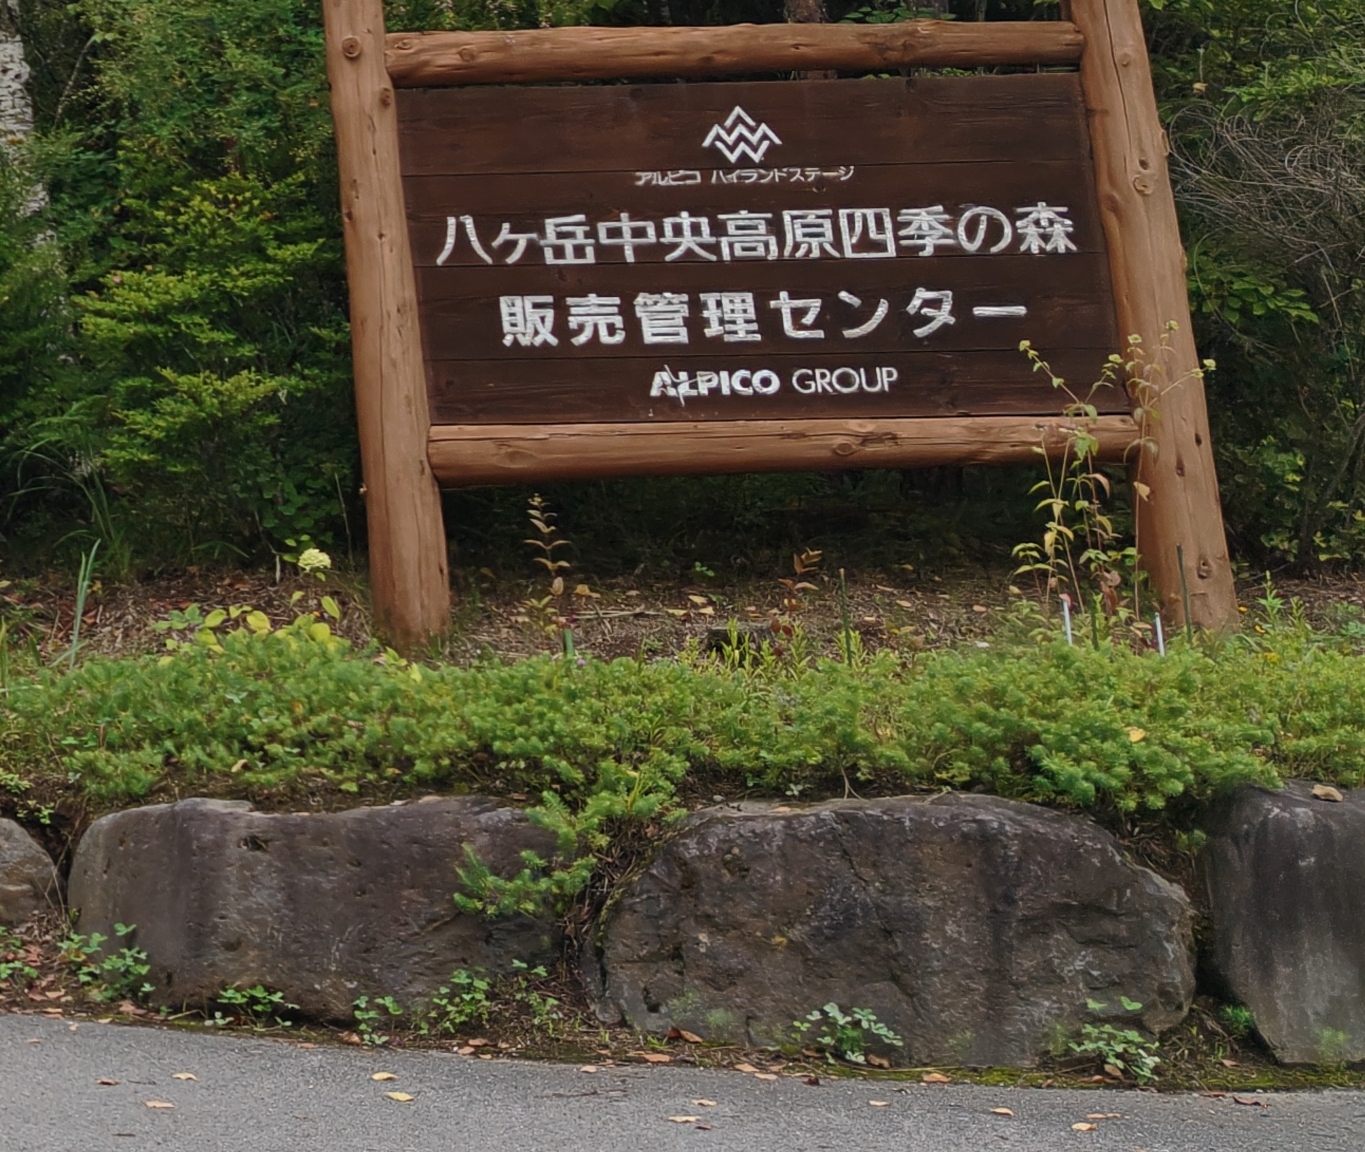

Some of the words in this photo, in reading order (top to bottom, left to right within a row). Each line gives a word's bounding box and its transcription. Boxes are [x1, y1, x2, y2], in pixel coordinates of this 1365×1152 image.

[635, 169, 702, 186] アルピコ
[711, 165, 855, 184] ハイランドステージ
[499, 287, 1028, 347] 販売管理センター
[649, 367, 781, 399] ALPICO
[791, 366, 899, 394] GROUP
